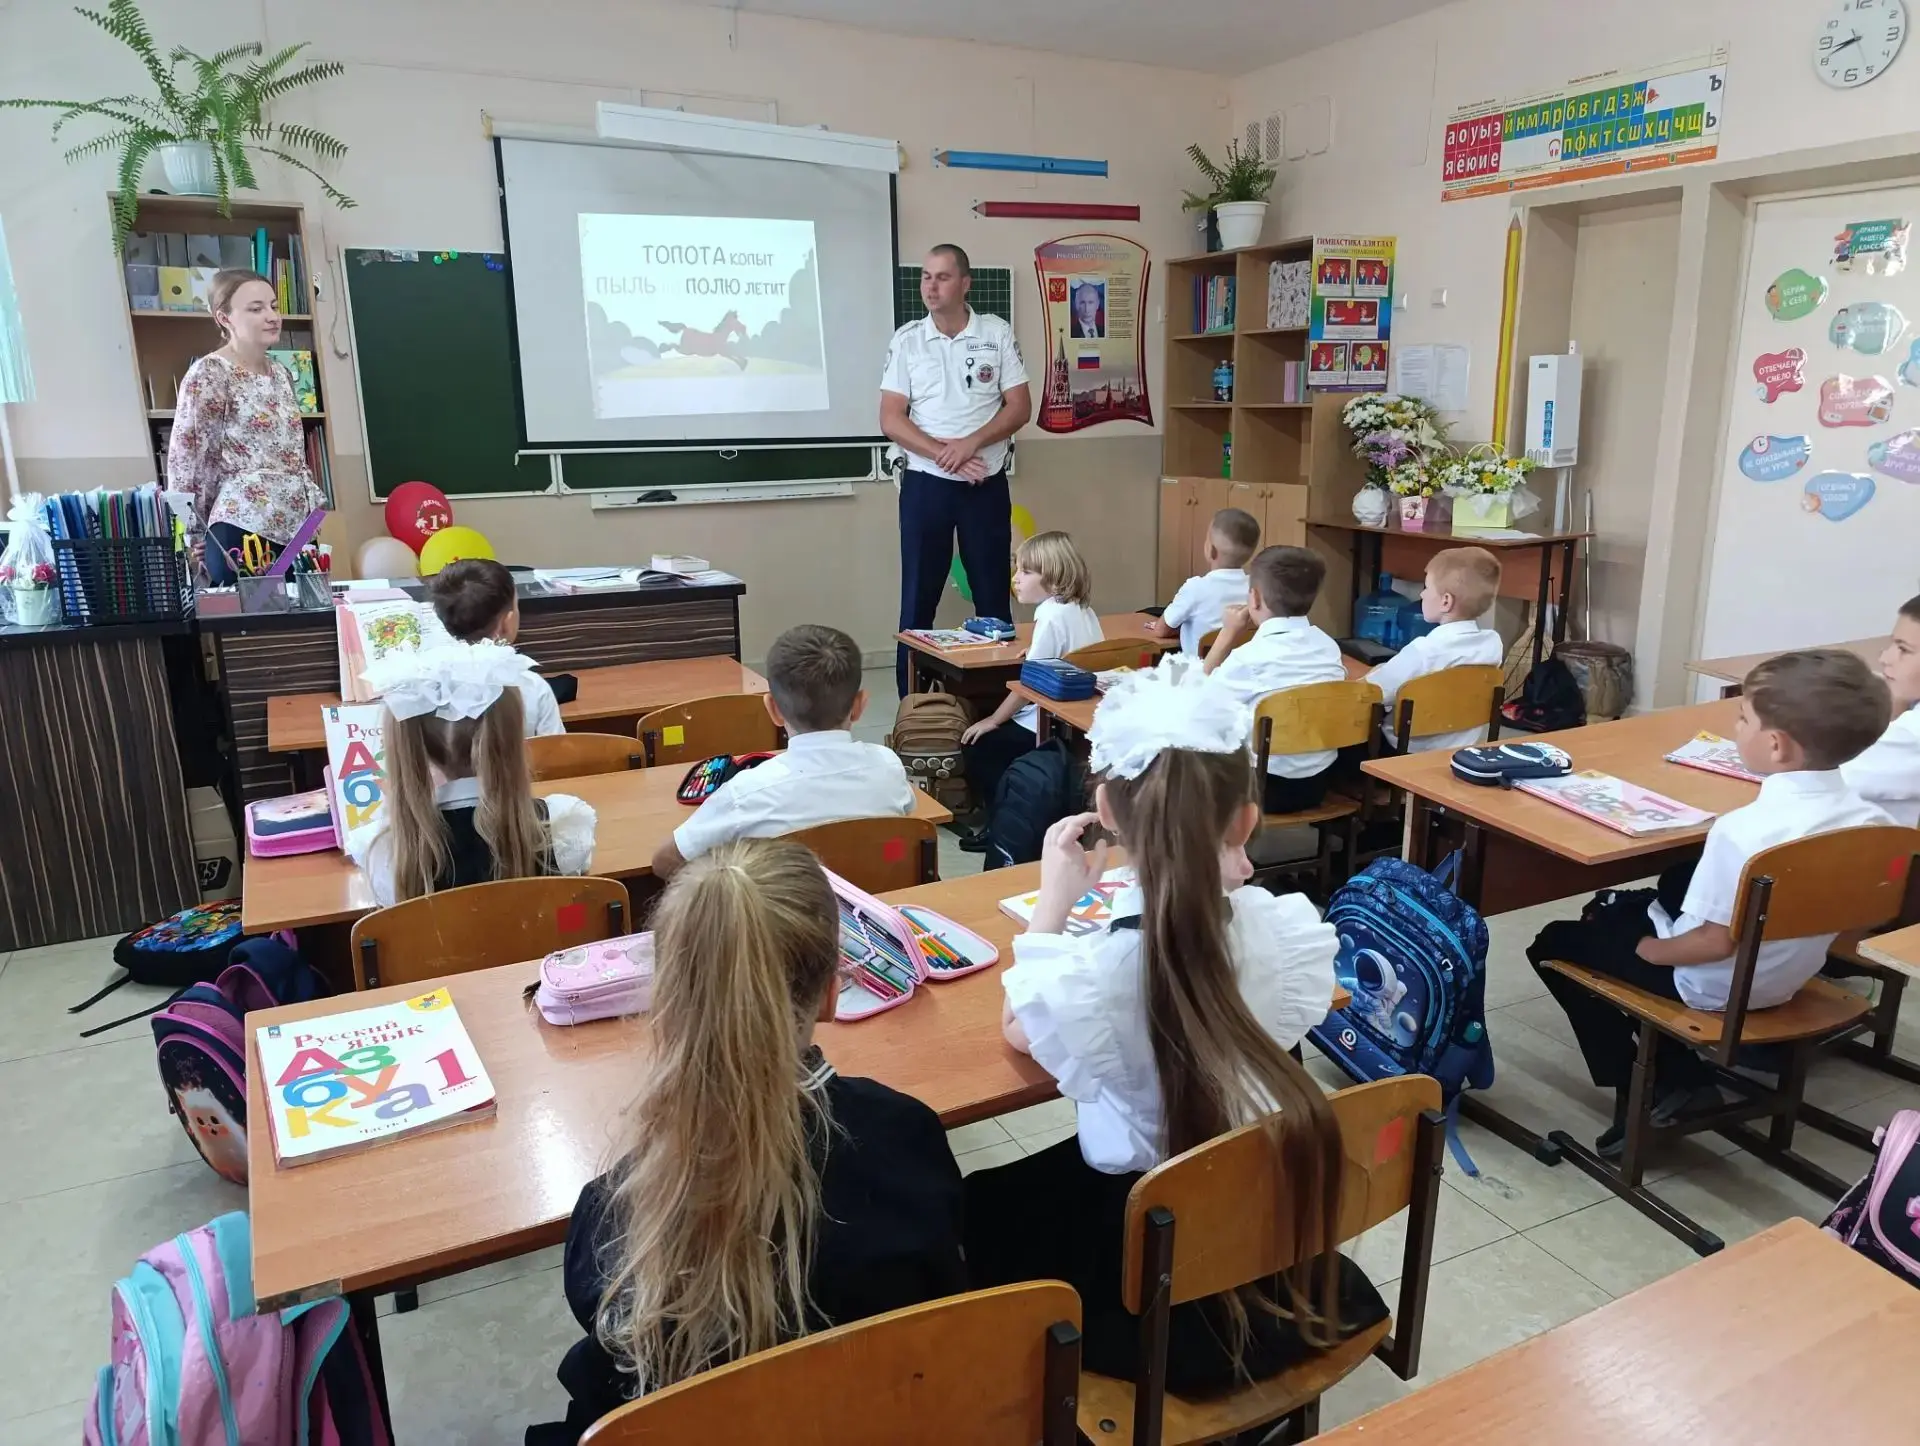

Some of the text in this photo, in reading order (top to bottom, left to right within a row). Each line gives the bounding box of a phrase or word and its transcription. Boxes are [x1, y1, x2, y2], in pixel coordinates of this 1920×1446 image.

[1889, 10, 1898, 19] 2
[1886, 26, 1900, 42] 3
[1818, 36, 1833, 50] 9
[1820, 57, 1829, 66] 8
[1844, 68, 1858, 82] 6
[641, 245, 726, 265] ТОПОТА
[596, 276, 656, 295] ПЫЛЬ
[685, 278, 741, 295] ПОЛЮ
[1766, 372, 1791, 383] СМЕЛО
